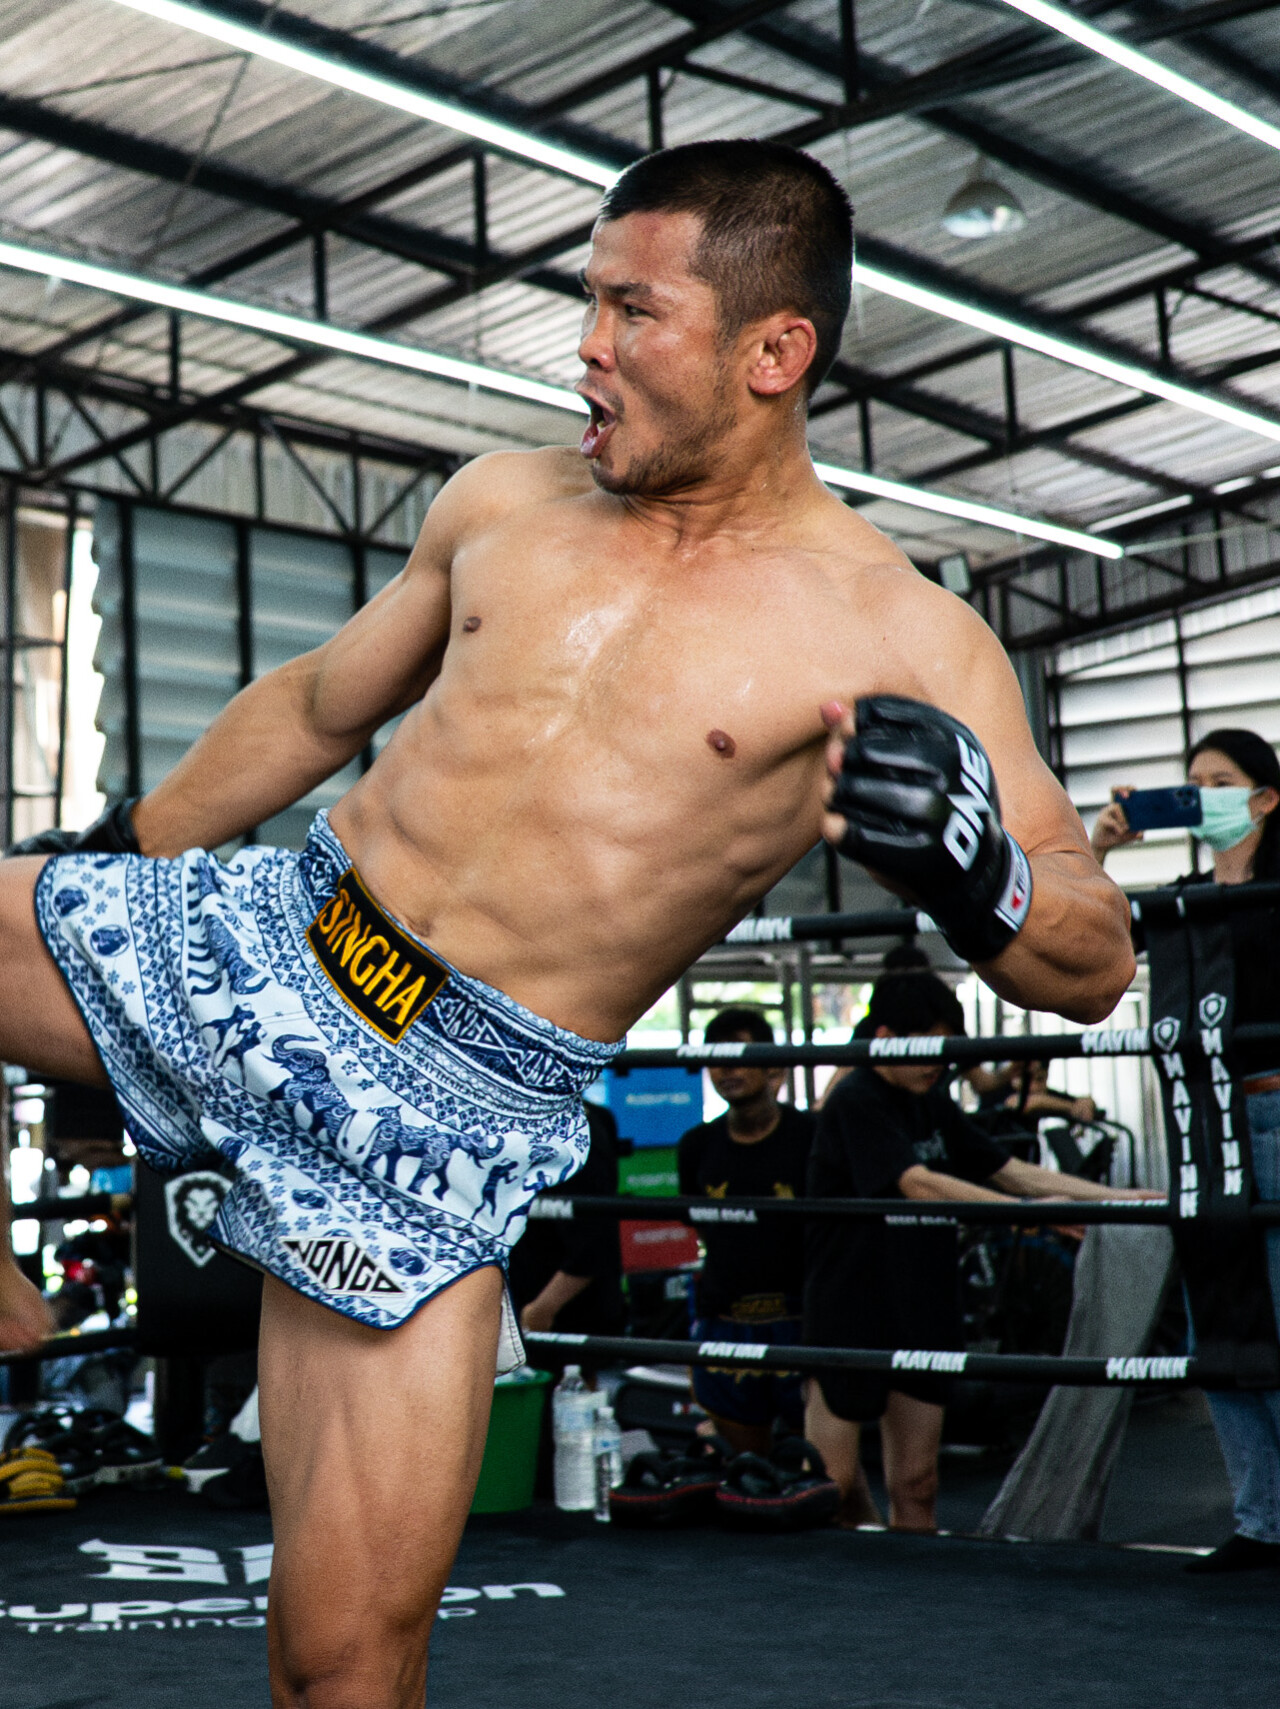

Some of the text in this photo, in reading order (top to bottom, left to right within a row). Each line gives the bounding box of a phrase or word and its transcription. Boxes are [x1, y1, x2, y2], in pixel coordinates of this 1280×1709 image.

[943, 733, 991, 871] ONE
[319, 888, 427, 1026] SINGHA
[282, 1240, 405, 1292] NONGO
